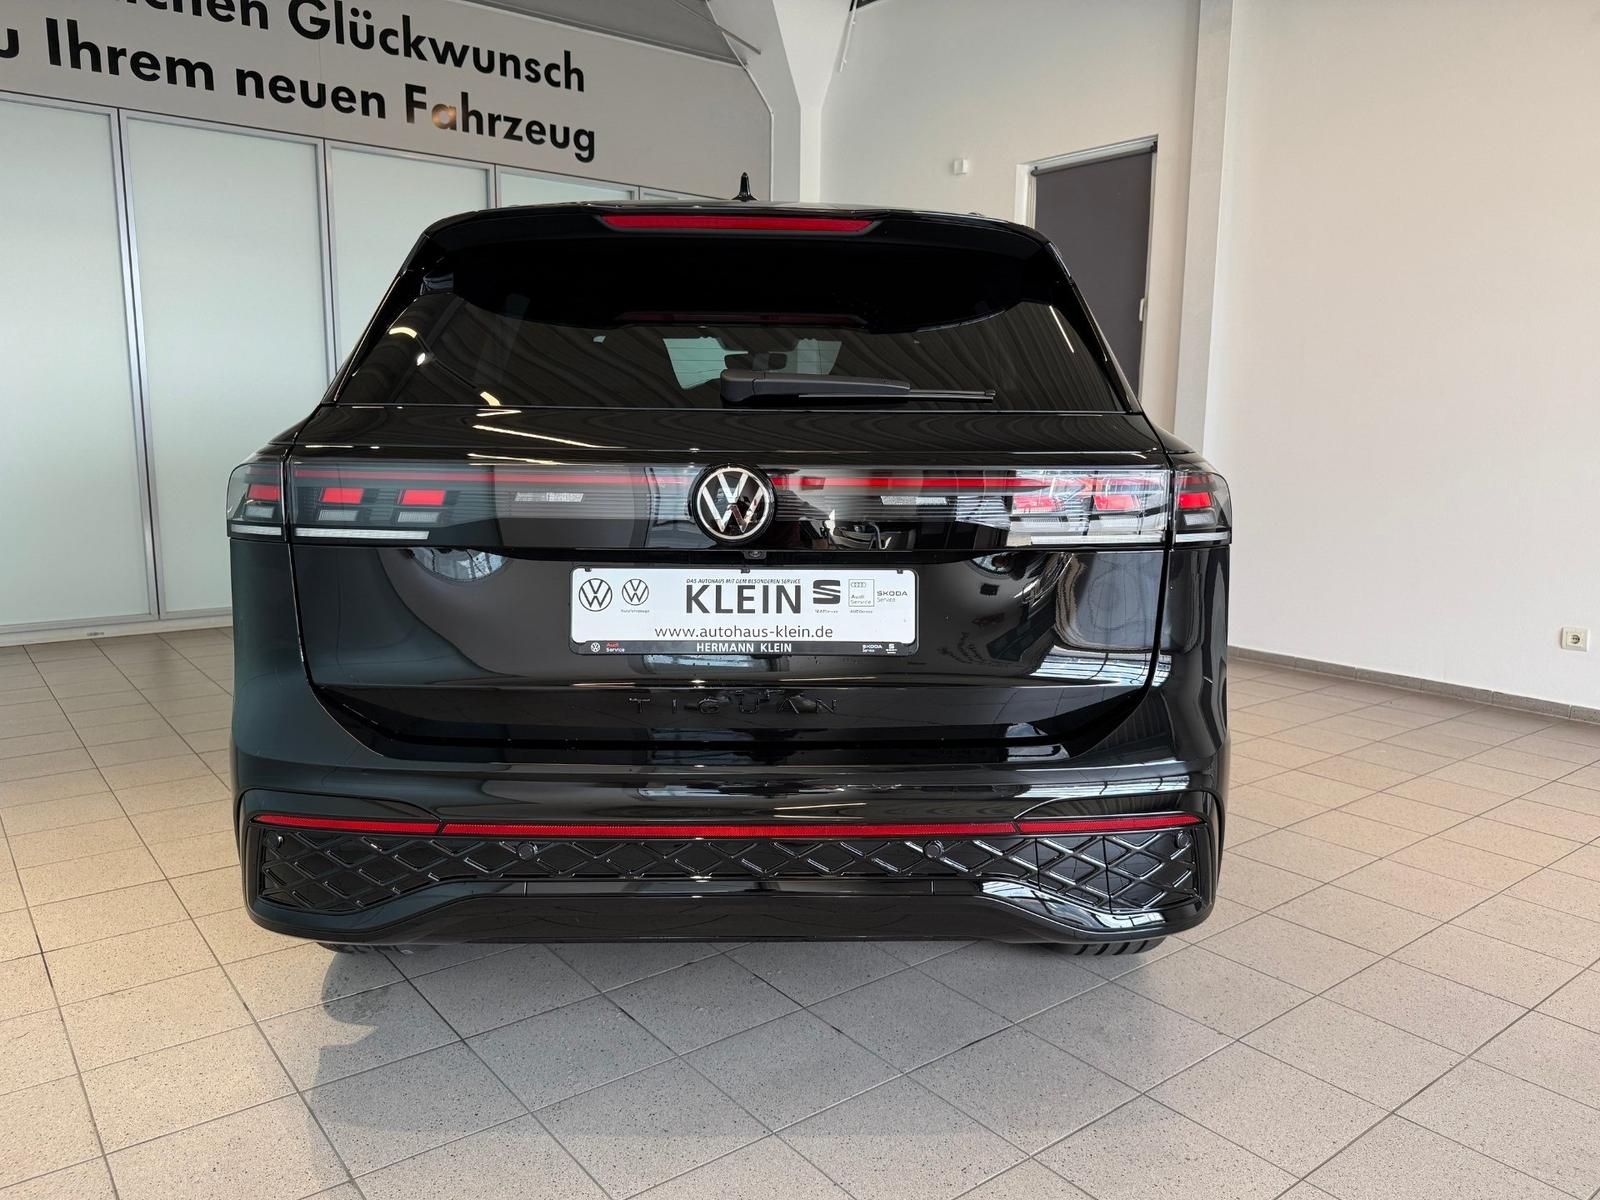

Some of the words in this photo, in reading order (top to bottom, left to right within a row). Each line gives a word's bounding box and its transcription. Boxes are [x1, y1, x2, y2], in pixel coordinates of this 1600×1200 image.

[288, 0, 585, 93] Glückwunsch
[46, 17, 215, 91] Ihrem
[235, 68, 386, 119] neuen
[405, 83, 595, 163] Fahrzeug
[686, 585, 801, 614] KLEIN
[655, 625, 833, 638] www.autohaus-klein.de
[696, 643, 754, 653] HERMANN
[760, 643, 792, 653] KLEIN
